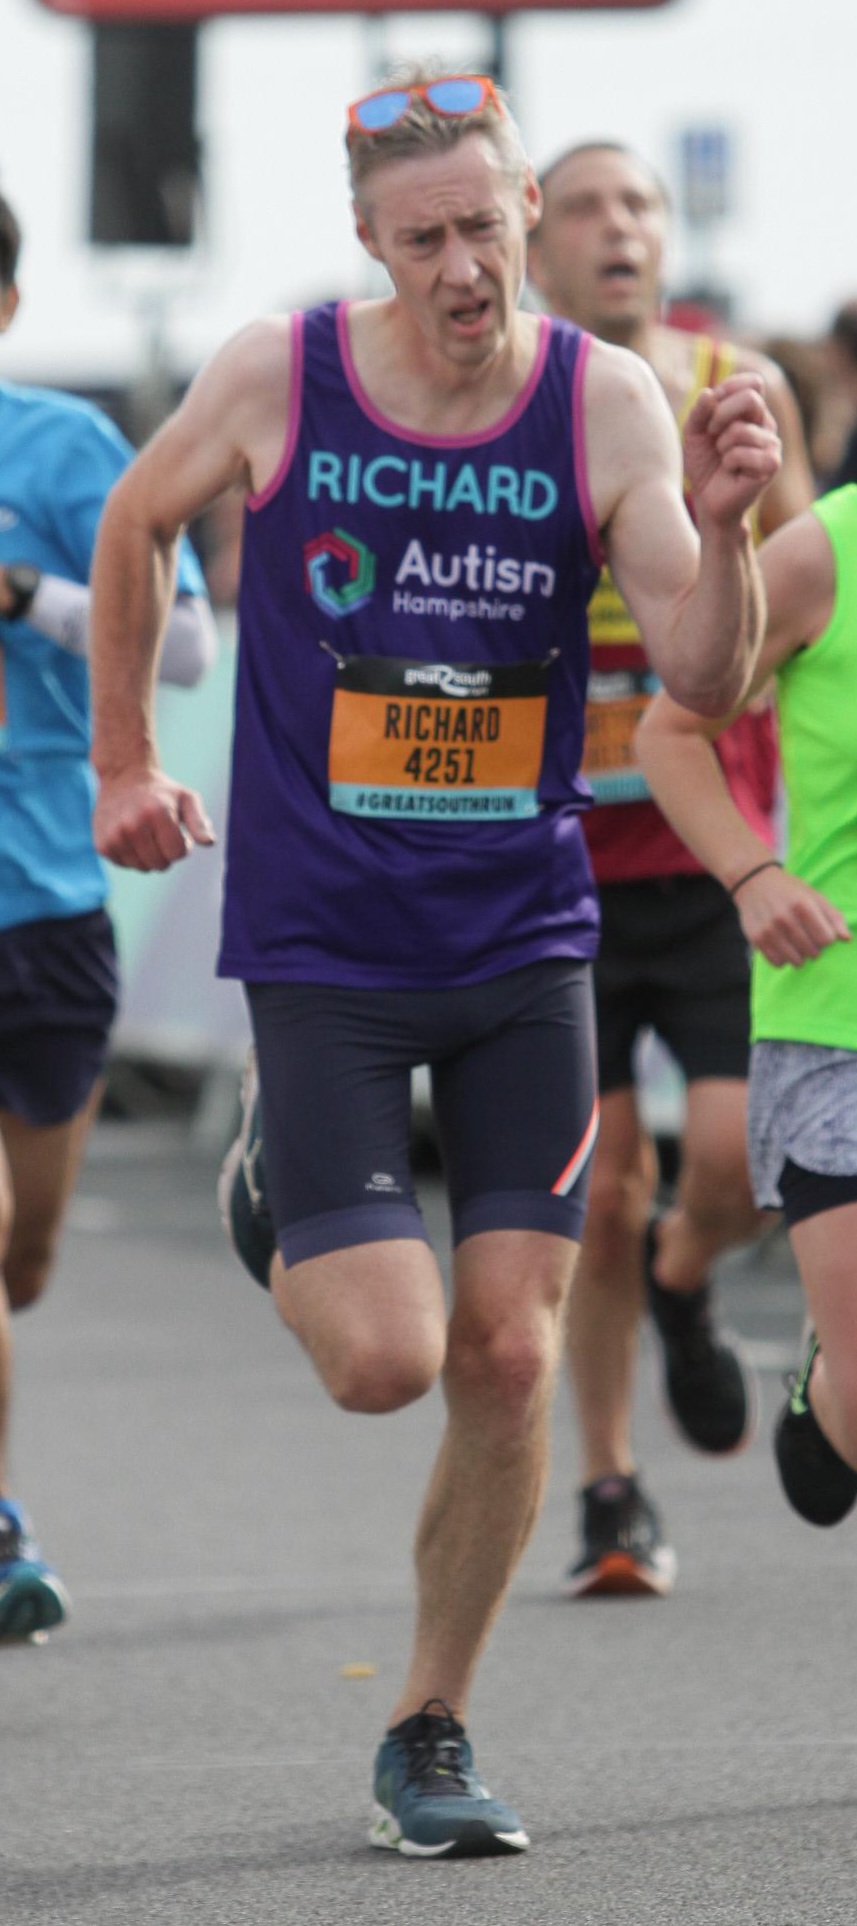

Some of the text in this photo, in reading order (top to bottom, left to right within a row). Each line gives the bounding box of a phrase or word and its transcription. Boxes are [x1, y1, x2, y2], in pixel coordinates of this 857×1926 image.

[307, 450, 559, 520] RICHARD
[393, 591, 526, 621] Hampshire
[404, 668, 439, 686] great
[384, 703, 501, 742] RICHARD
[404, 748, 475, 784] 4251
[356, 794, 516, 813] #GREATSOUTHRUN
